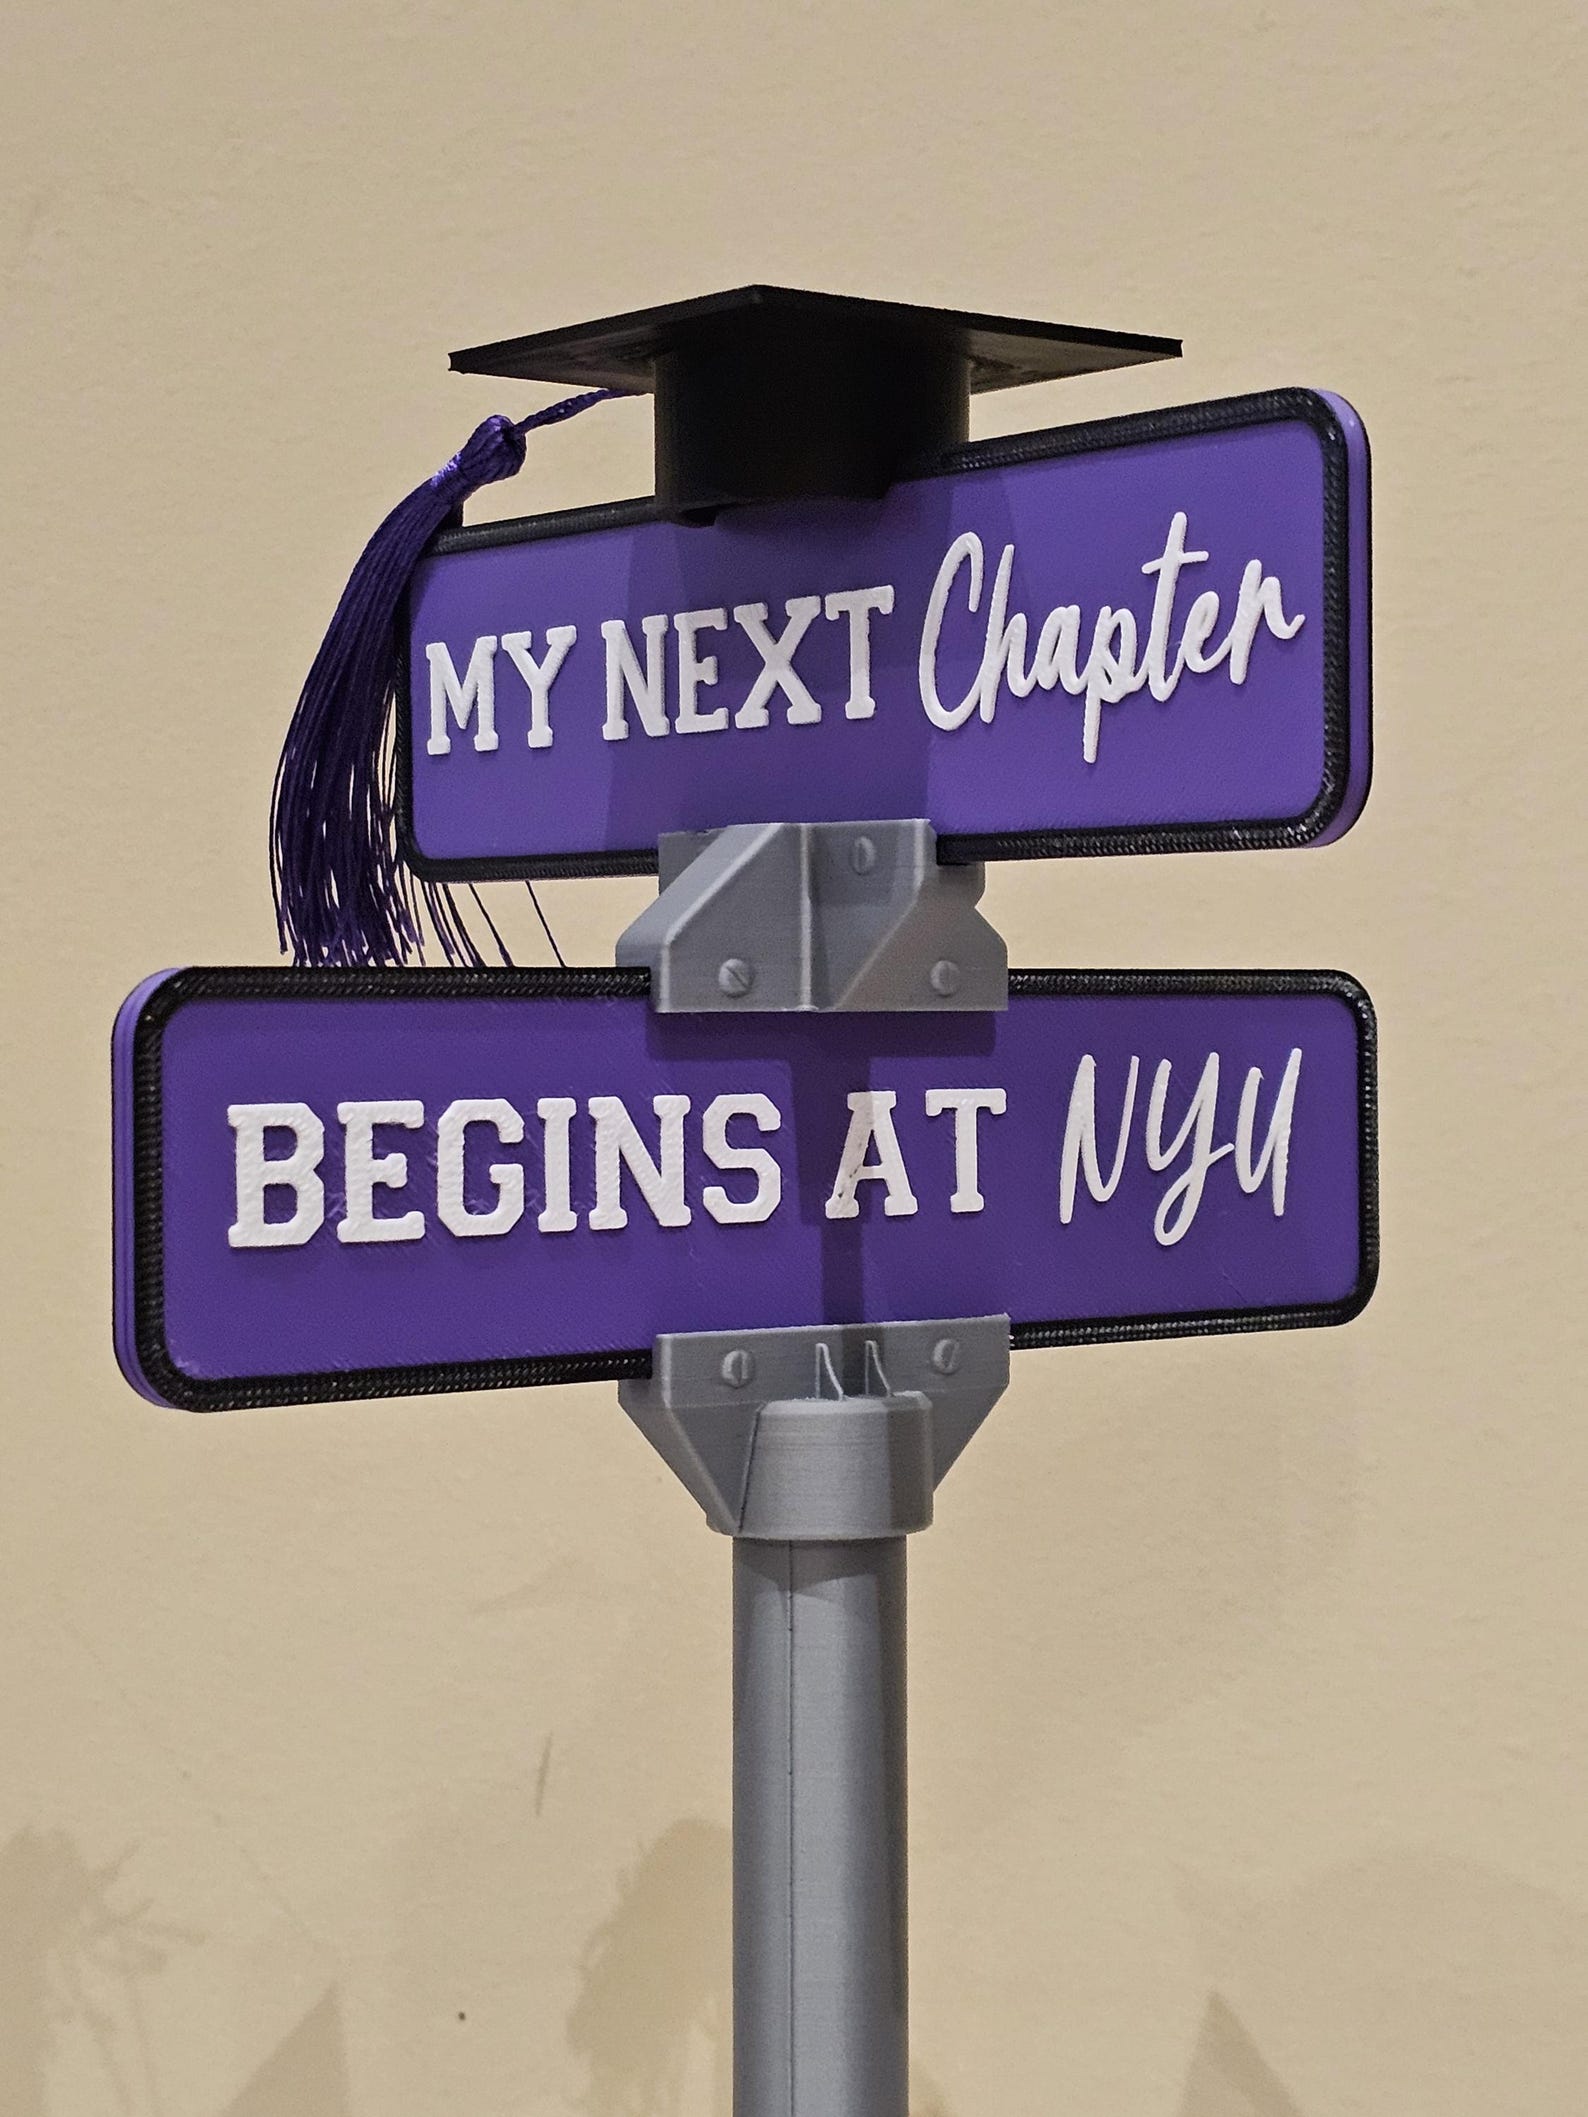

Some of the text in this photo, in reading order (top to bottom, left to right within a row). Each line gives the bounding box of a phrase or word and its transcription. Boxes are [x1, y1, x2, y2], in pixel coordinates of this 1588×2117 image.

[424, 510, 1306, 764] MY NEXT Chapter
[226, 1046, 1304, 1250] BEGINS AT NYU
